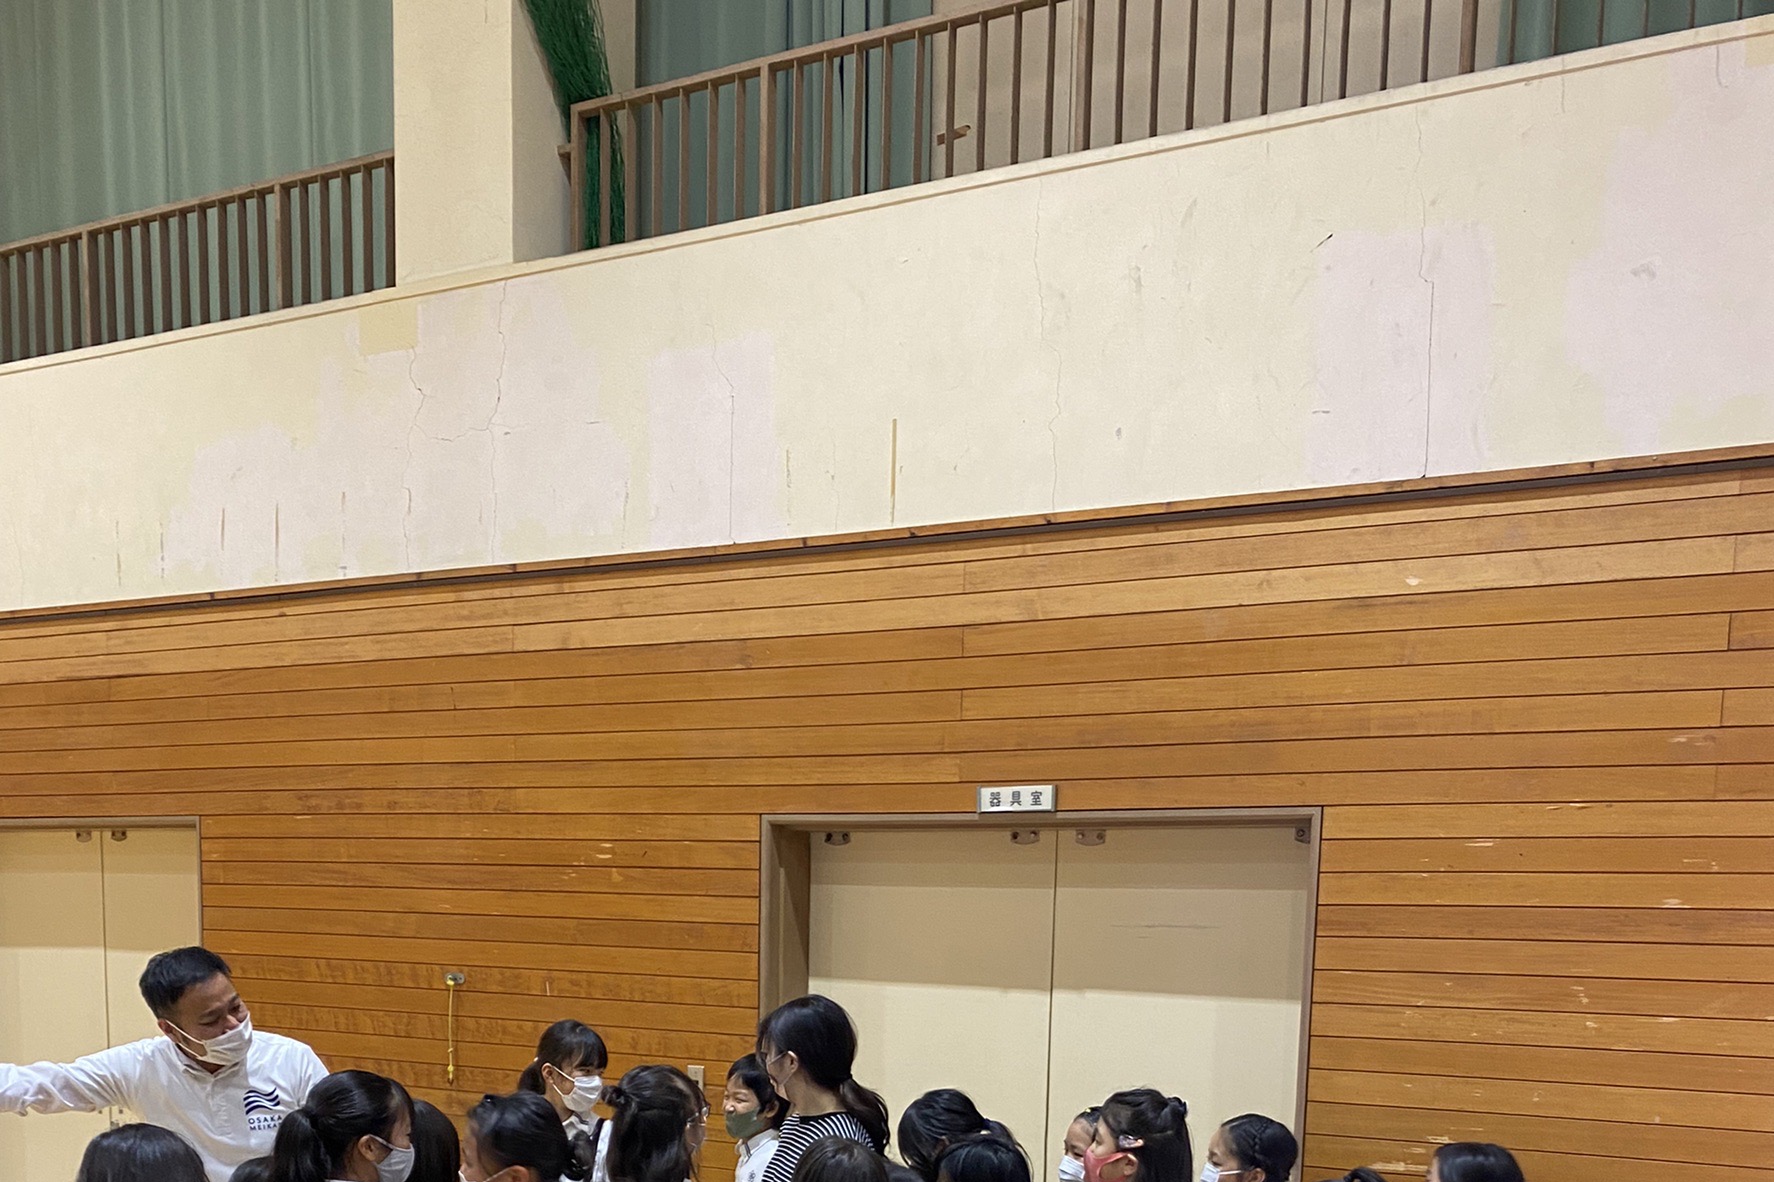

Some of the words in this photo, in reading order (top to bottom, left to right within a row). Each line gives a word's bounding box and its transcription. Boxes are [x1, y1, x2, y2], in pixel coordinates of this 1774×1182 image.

[989, 790, 1042, 807] 器具室
[248, 1115, 282, 1124] OSAKA
[249, 1122, 281, 1131] MEIKA
